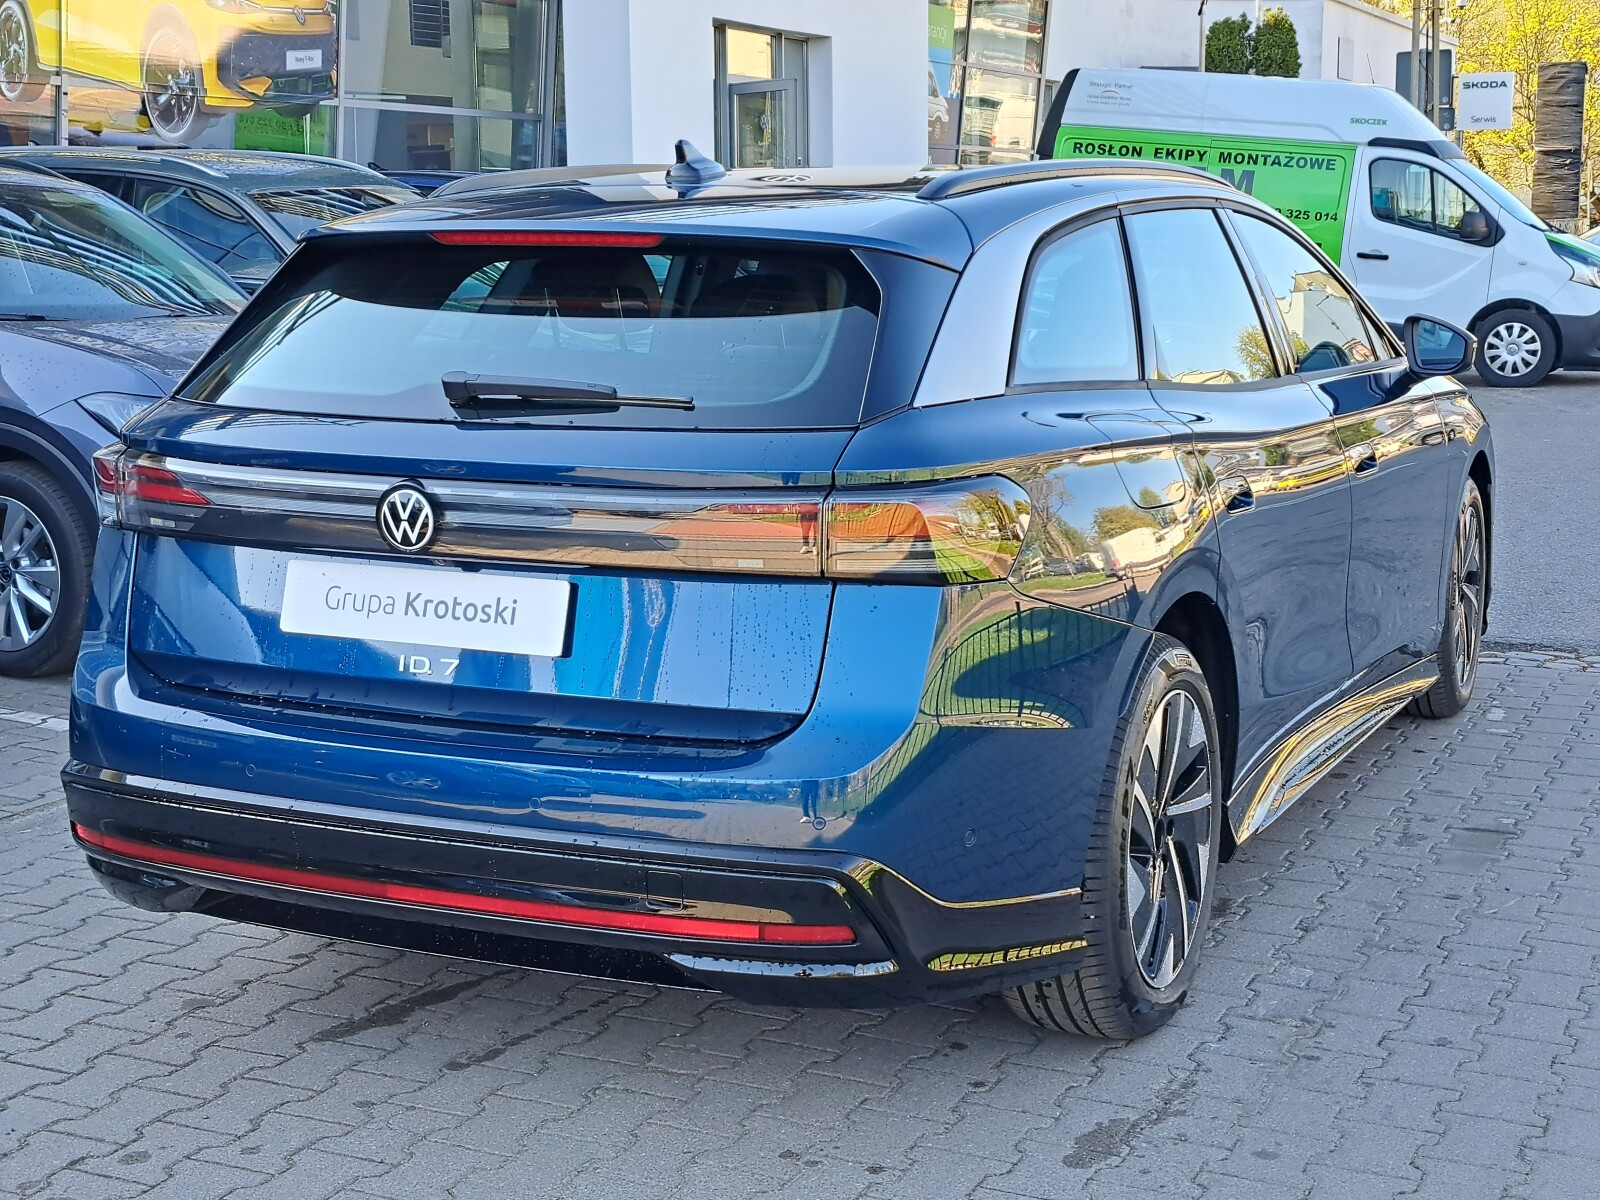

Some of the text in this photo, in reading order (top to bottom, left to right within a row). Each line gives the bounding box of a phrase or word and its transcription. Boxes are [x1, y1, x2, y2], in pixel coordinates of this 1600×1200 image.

[1462, 80, 1508, 90] SKODA
[1350, 117, 1388, 126] SKOCZEK
[1470, 115, 1497, 123] Serwis
[1072, 141, 1337, 171] ROSŁON EKIPY MONTAŻOWE
[1285, 208, 1310, 220] 325
[1314, 211, 1338, 222] 014
[325, 585, 518, 626] Grupa Krotoski
